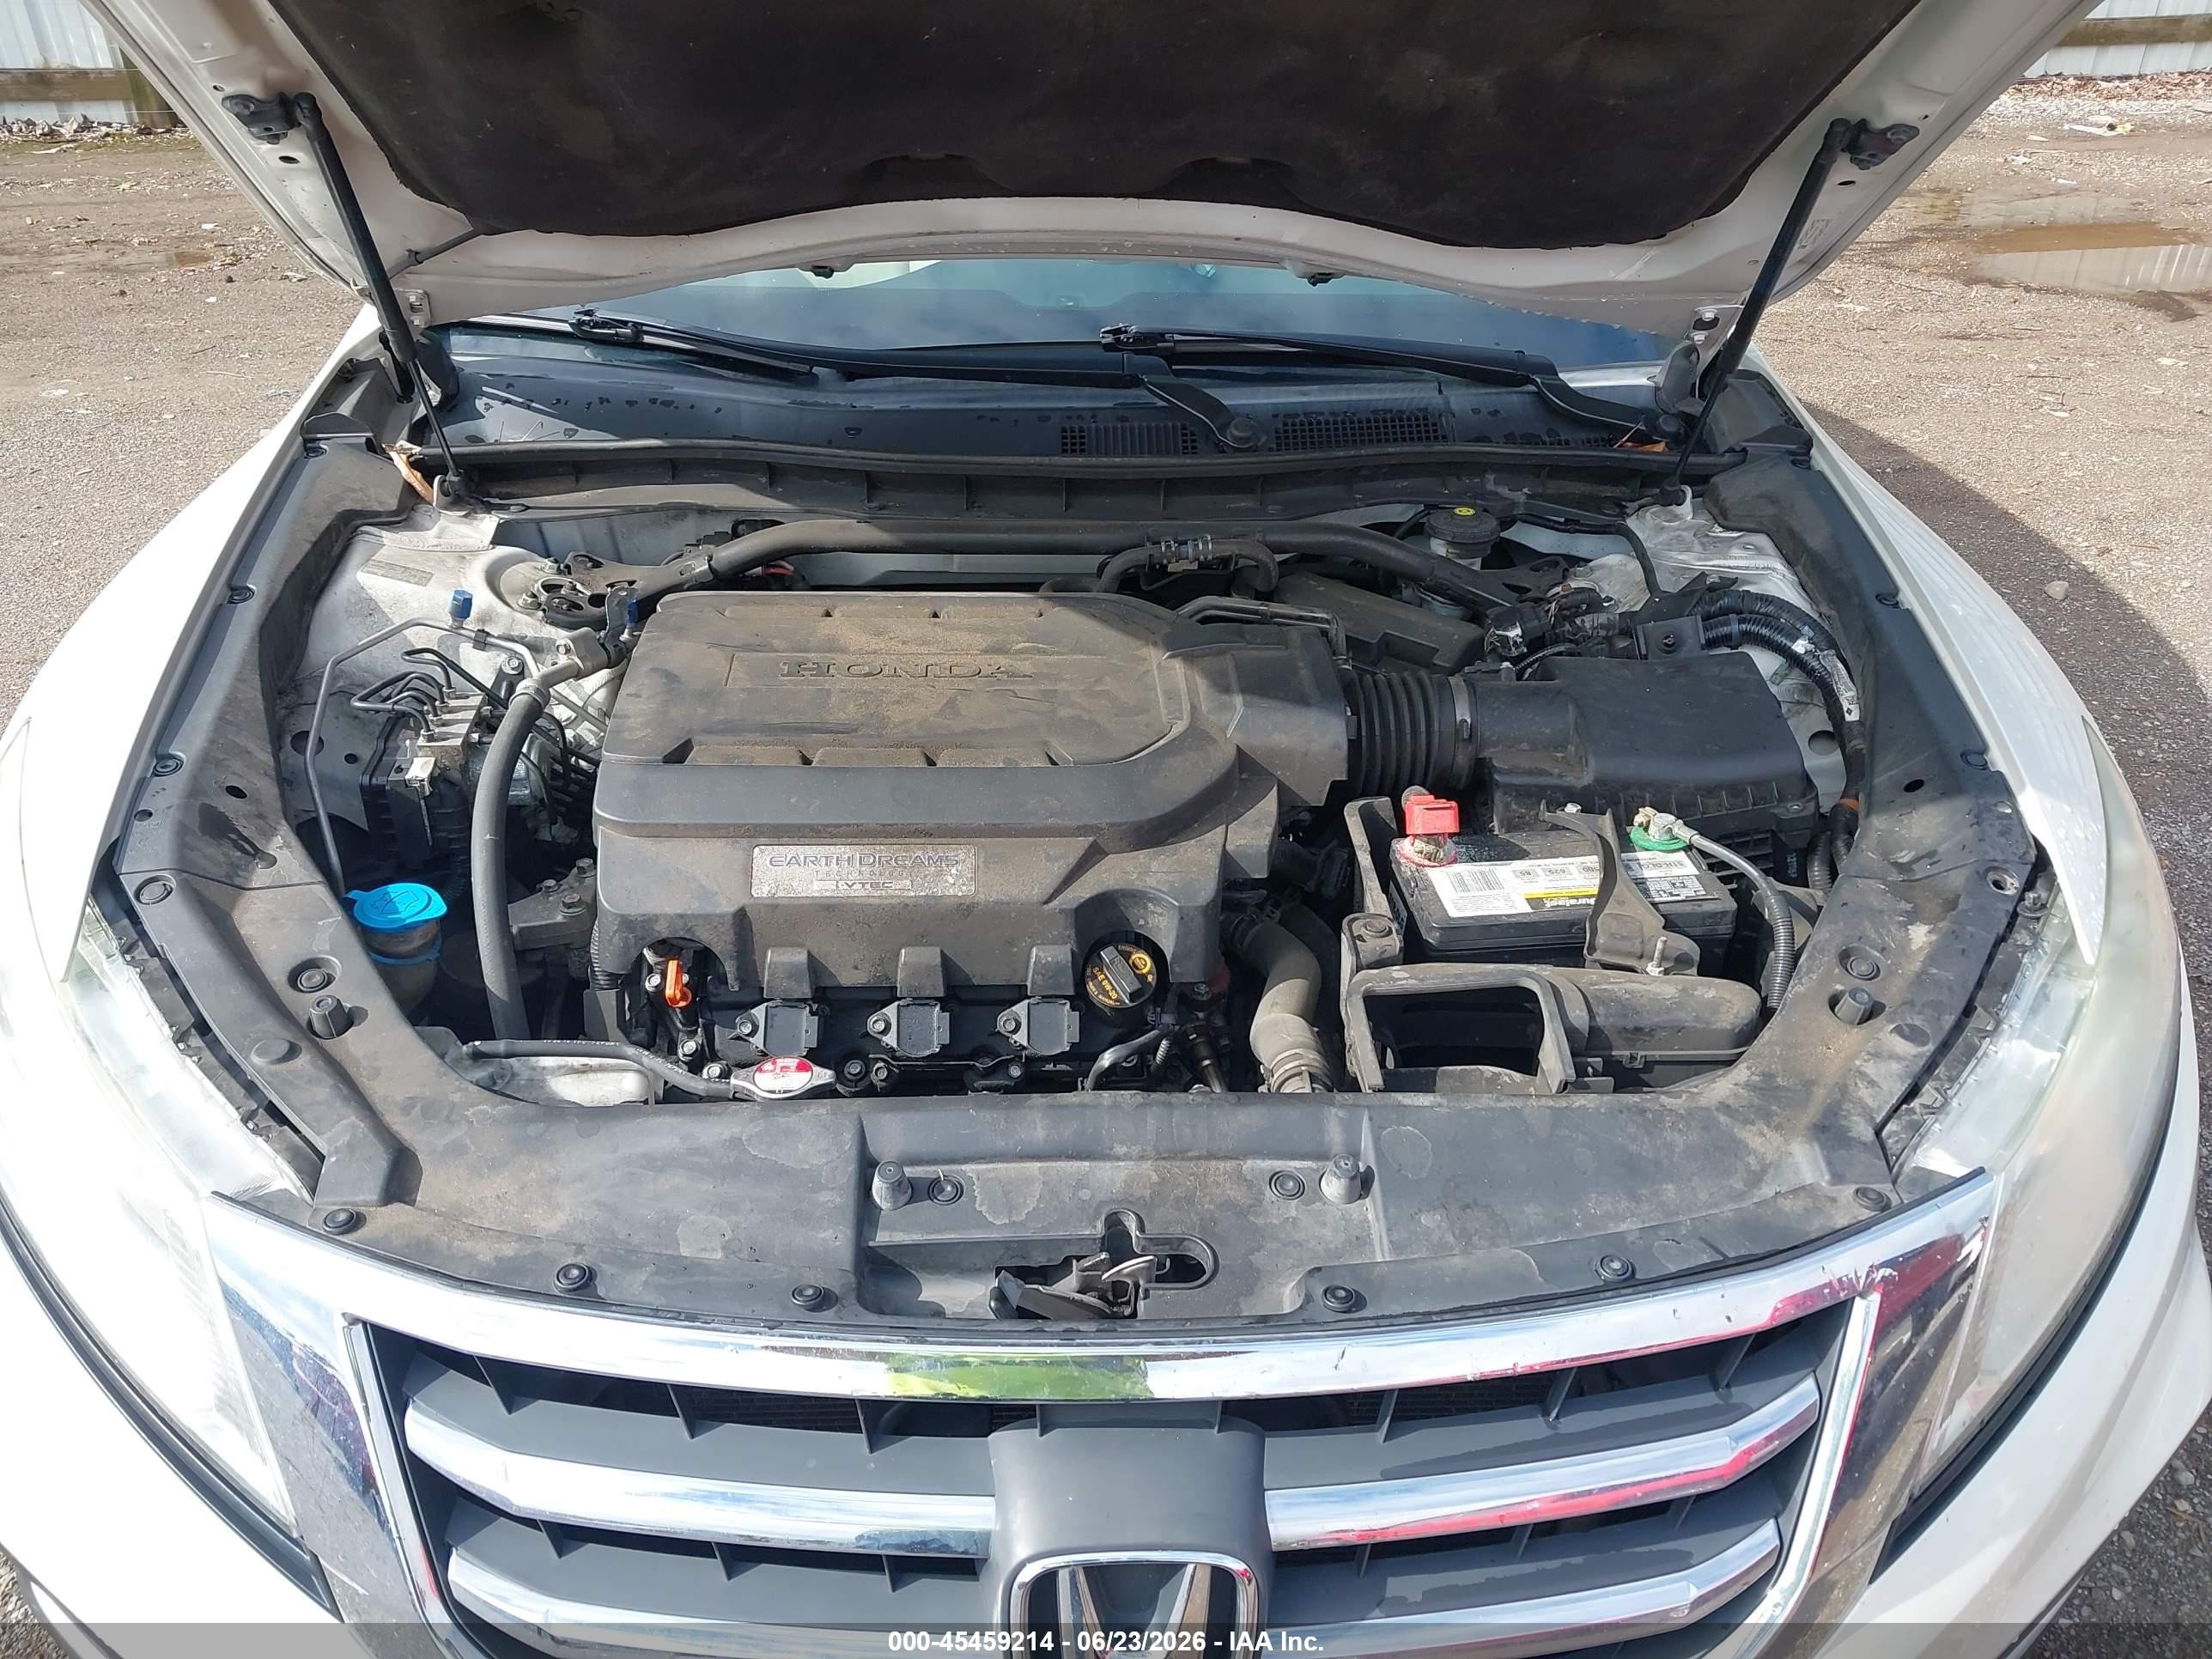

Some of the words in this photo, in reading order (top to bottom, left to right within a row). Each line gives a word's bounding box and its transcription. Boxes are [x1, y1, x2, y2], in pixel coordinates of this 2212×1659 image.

[781, 660, 1032, 678] HONDA
[769, 853, 853, 866] EARTH
[858, 853, 960, 866] DREAMS
[1092, 967, 1106, 981] SAE
[1102, 980, 1118, 1000] 0W-20
